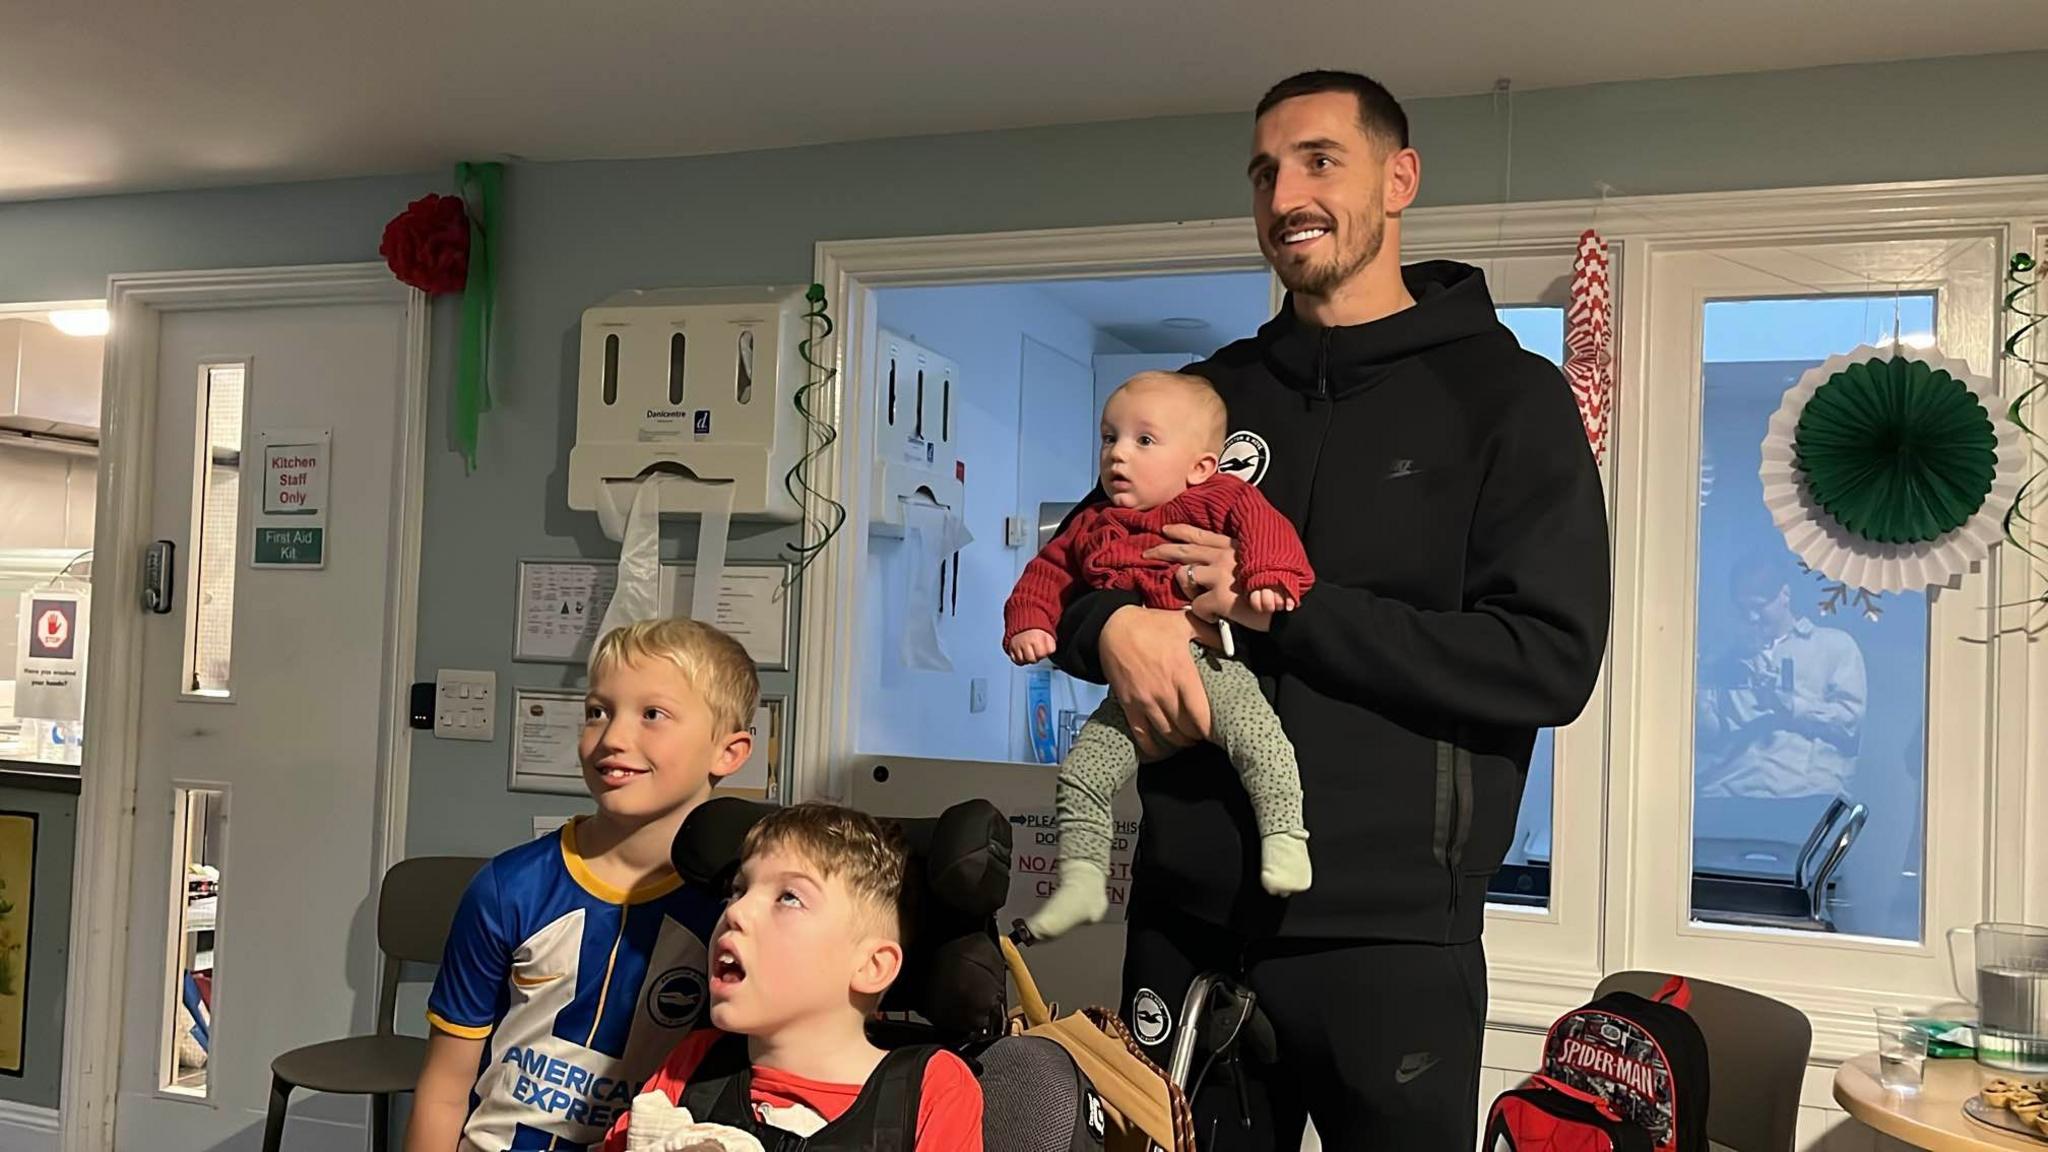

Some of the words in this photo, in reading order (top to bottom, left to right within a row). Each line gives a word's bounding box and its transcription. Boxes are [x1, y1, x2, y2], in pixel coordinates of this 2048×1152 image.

[272, 456, 316, 469] Kitchen
[280, 473, 308, 486] Staff
[280, 491, 306, 506] Only
[266, 530, 291, 544] First
[293, 530, 313, 545] Aid
[280, 547, 296, 560] Kit
[1020, 856, 1046, 871] NO
[1558, 1039, 1654, 1099] SPIDER-MAN
